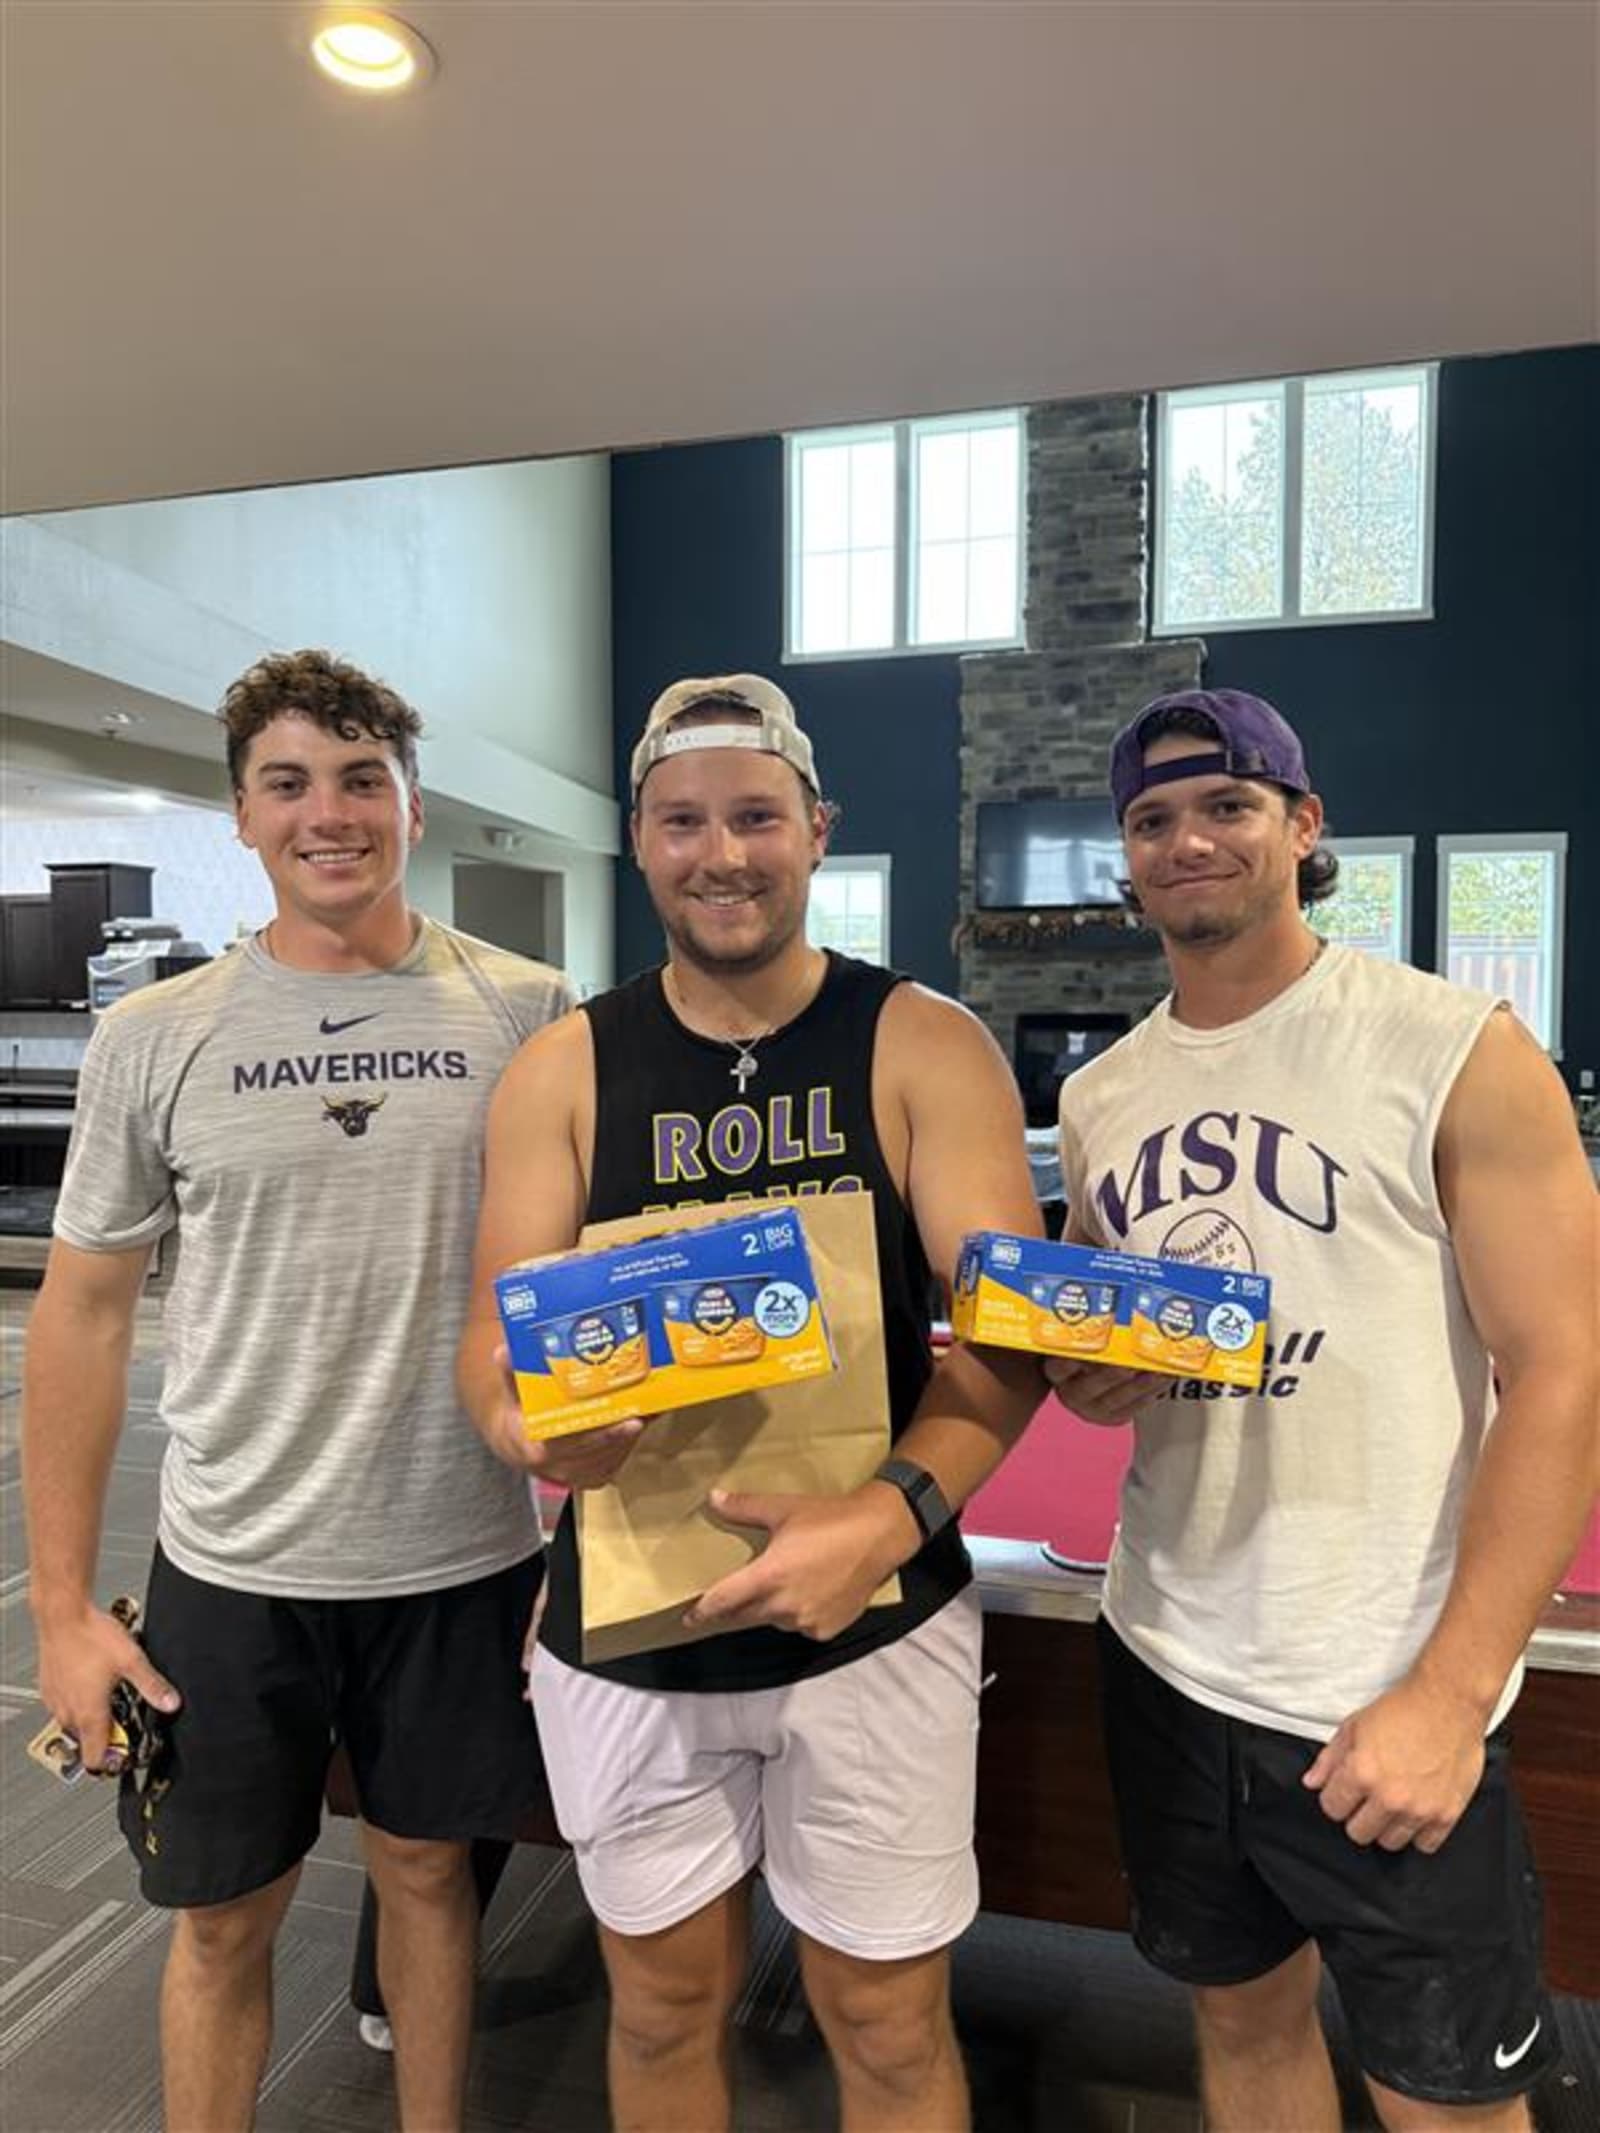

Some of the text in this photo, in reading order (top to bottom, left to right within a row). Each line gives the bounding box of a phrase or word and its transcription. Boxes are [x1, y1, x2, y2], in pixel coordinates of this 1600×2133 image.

[233, 1050, 468, 1095] MAVERICKS
[652, 1086, 846, 1184] ROLL
[1095, 1110, 1349, 1239] MSU
[742, 1233, 760, 1257] 2
[1221, 1275, 1236, 1295] 2
[764, 1289, 798, 1314] 2x
[1215, 1305, 1247, 1332] 2x
